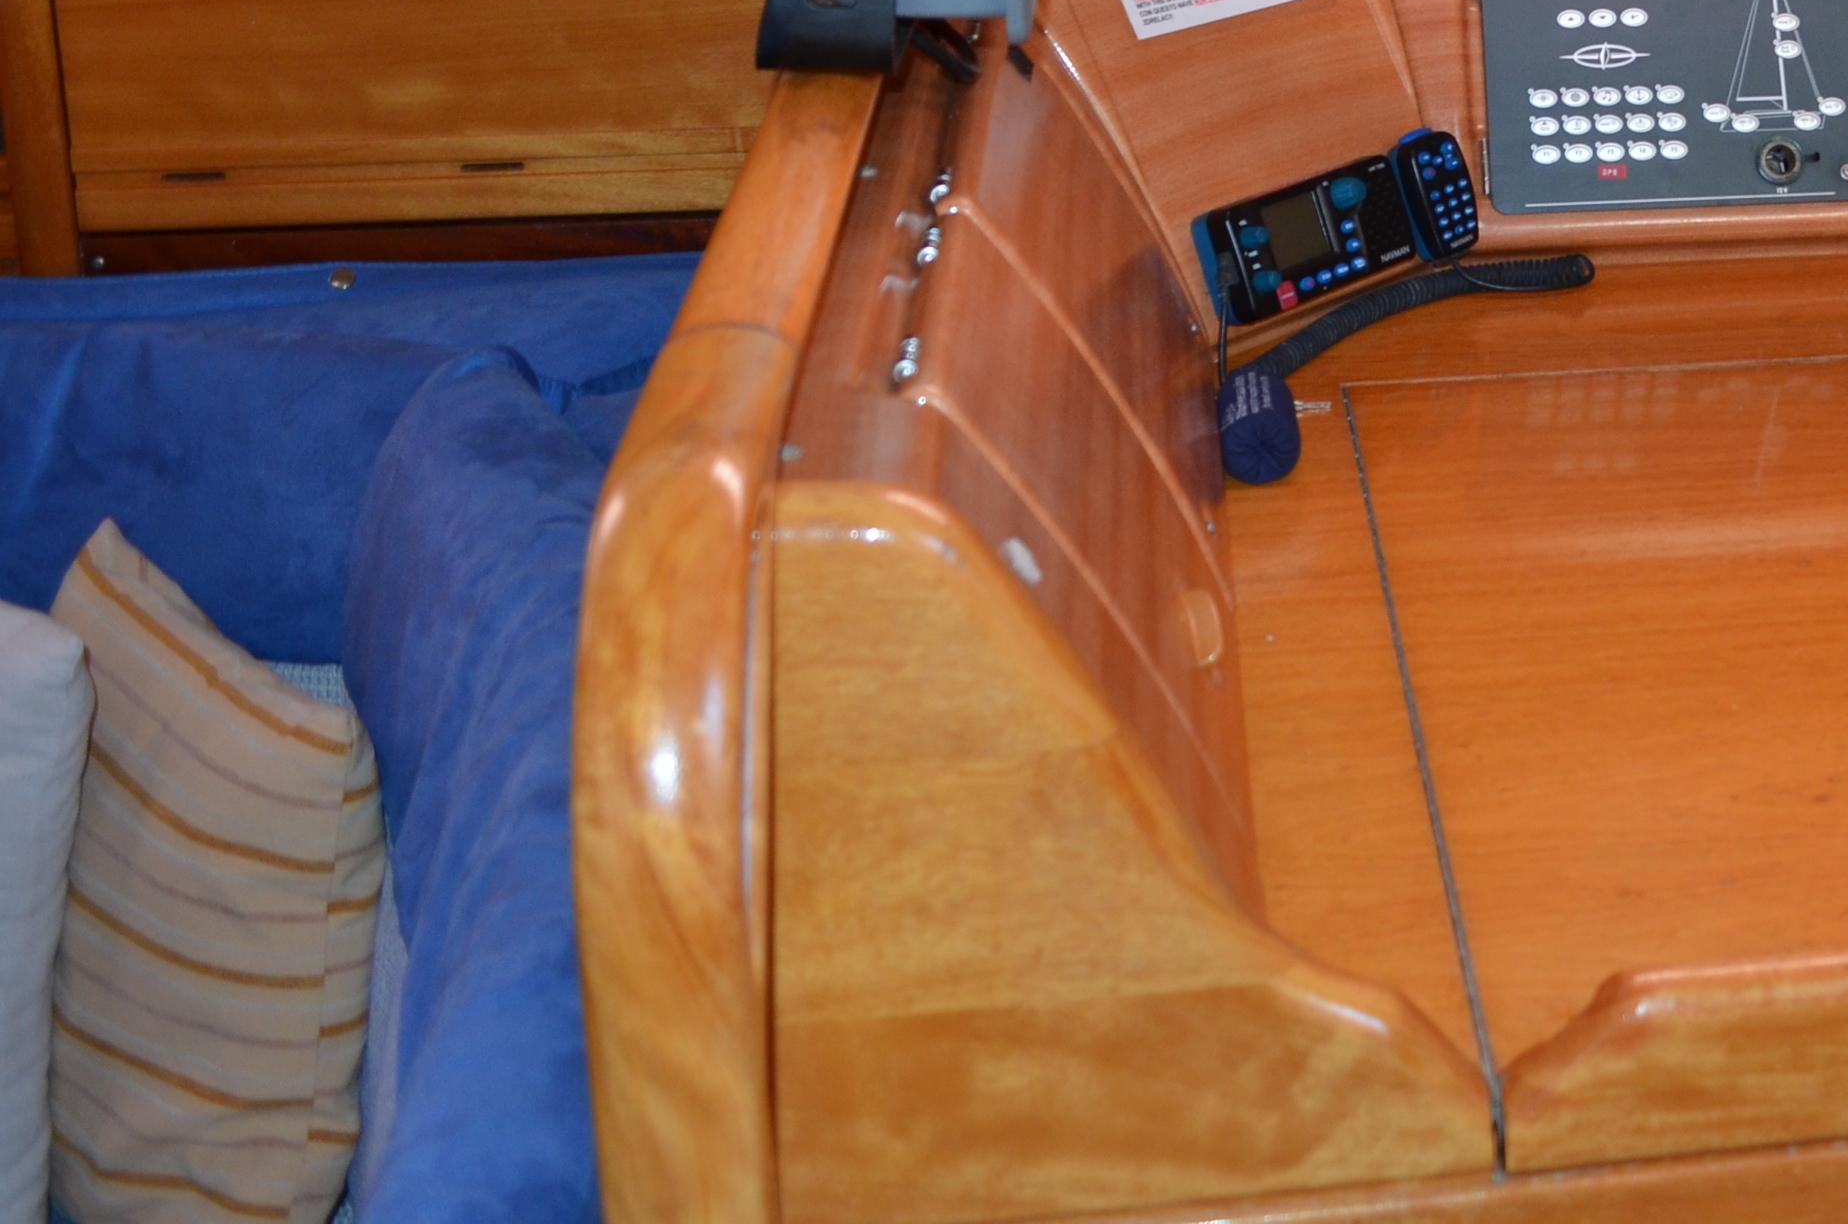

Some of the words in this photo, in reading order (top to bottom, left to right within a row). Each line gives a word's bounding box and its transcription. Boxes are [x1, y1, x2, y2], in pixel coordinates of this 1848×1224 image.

[1136, 1, 1152, 10] WITH
[1140, 10, 1153, 18] CON
[1153, 4, 1177, 15] QUESTO
[1178, 0, 1194, 9] NAVE
[1381, 244, 1411, 264] NAVMAN
